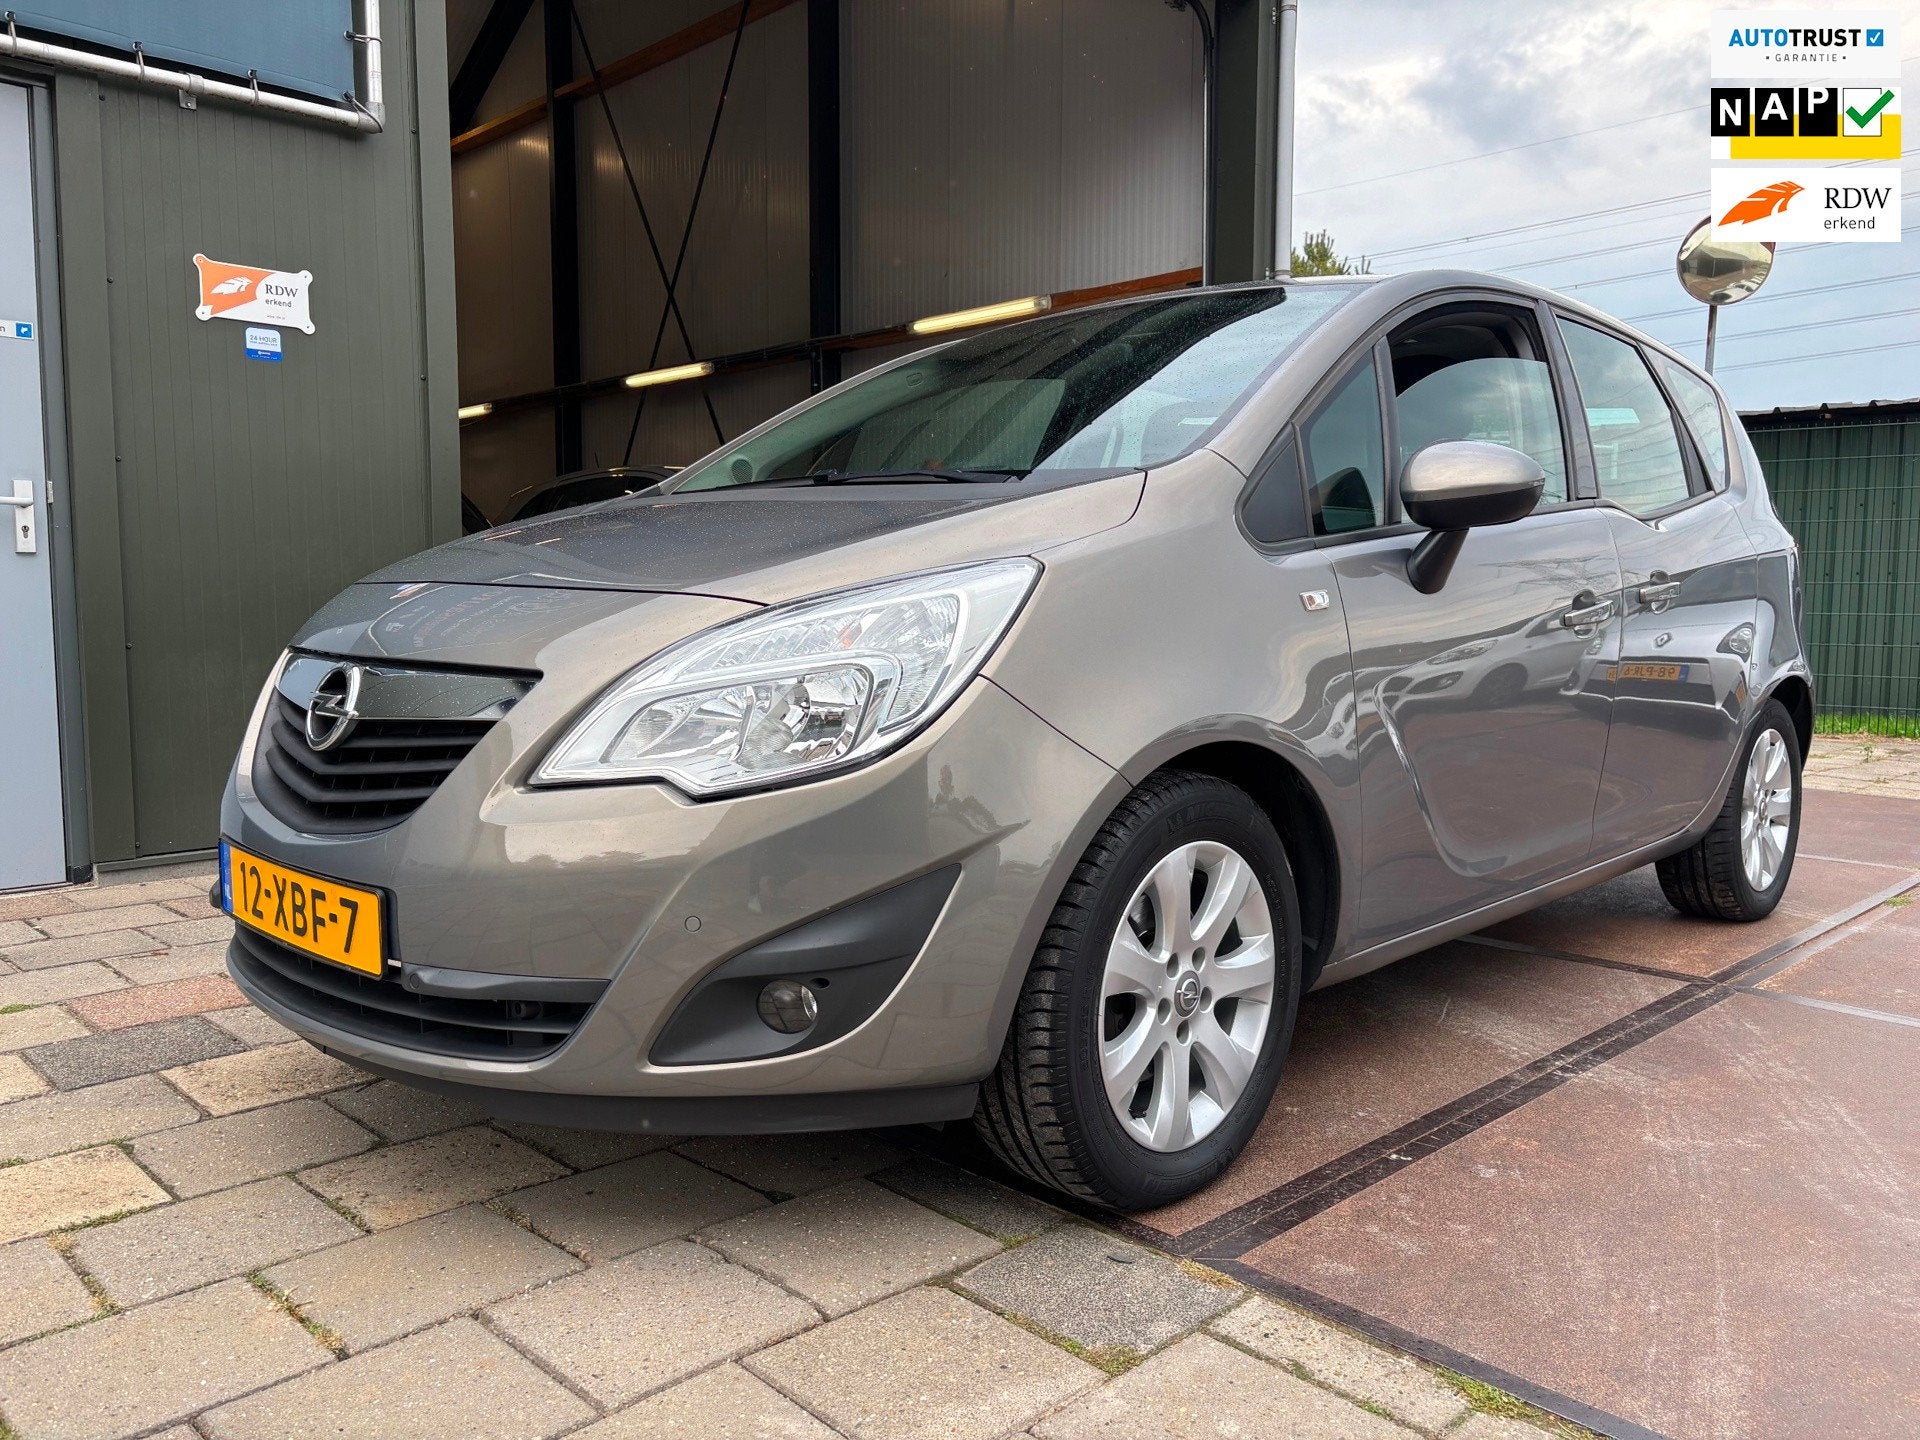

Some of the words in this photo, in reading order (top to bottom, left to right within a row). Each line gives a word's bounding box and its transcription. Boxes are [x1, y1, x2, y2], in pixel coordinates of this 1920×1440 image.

[265, 284, 298, 297] RDW
[265, 298, 292, 307] erkend
[259, 335, 278, 343] HOUR
[239, 861, 359, 954] 12-XBF-7
